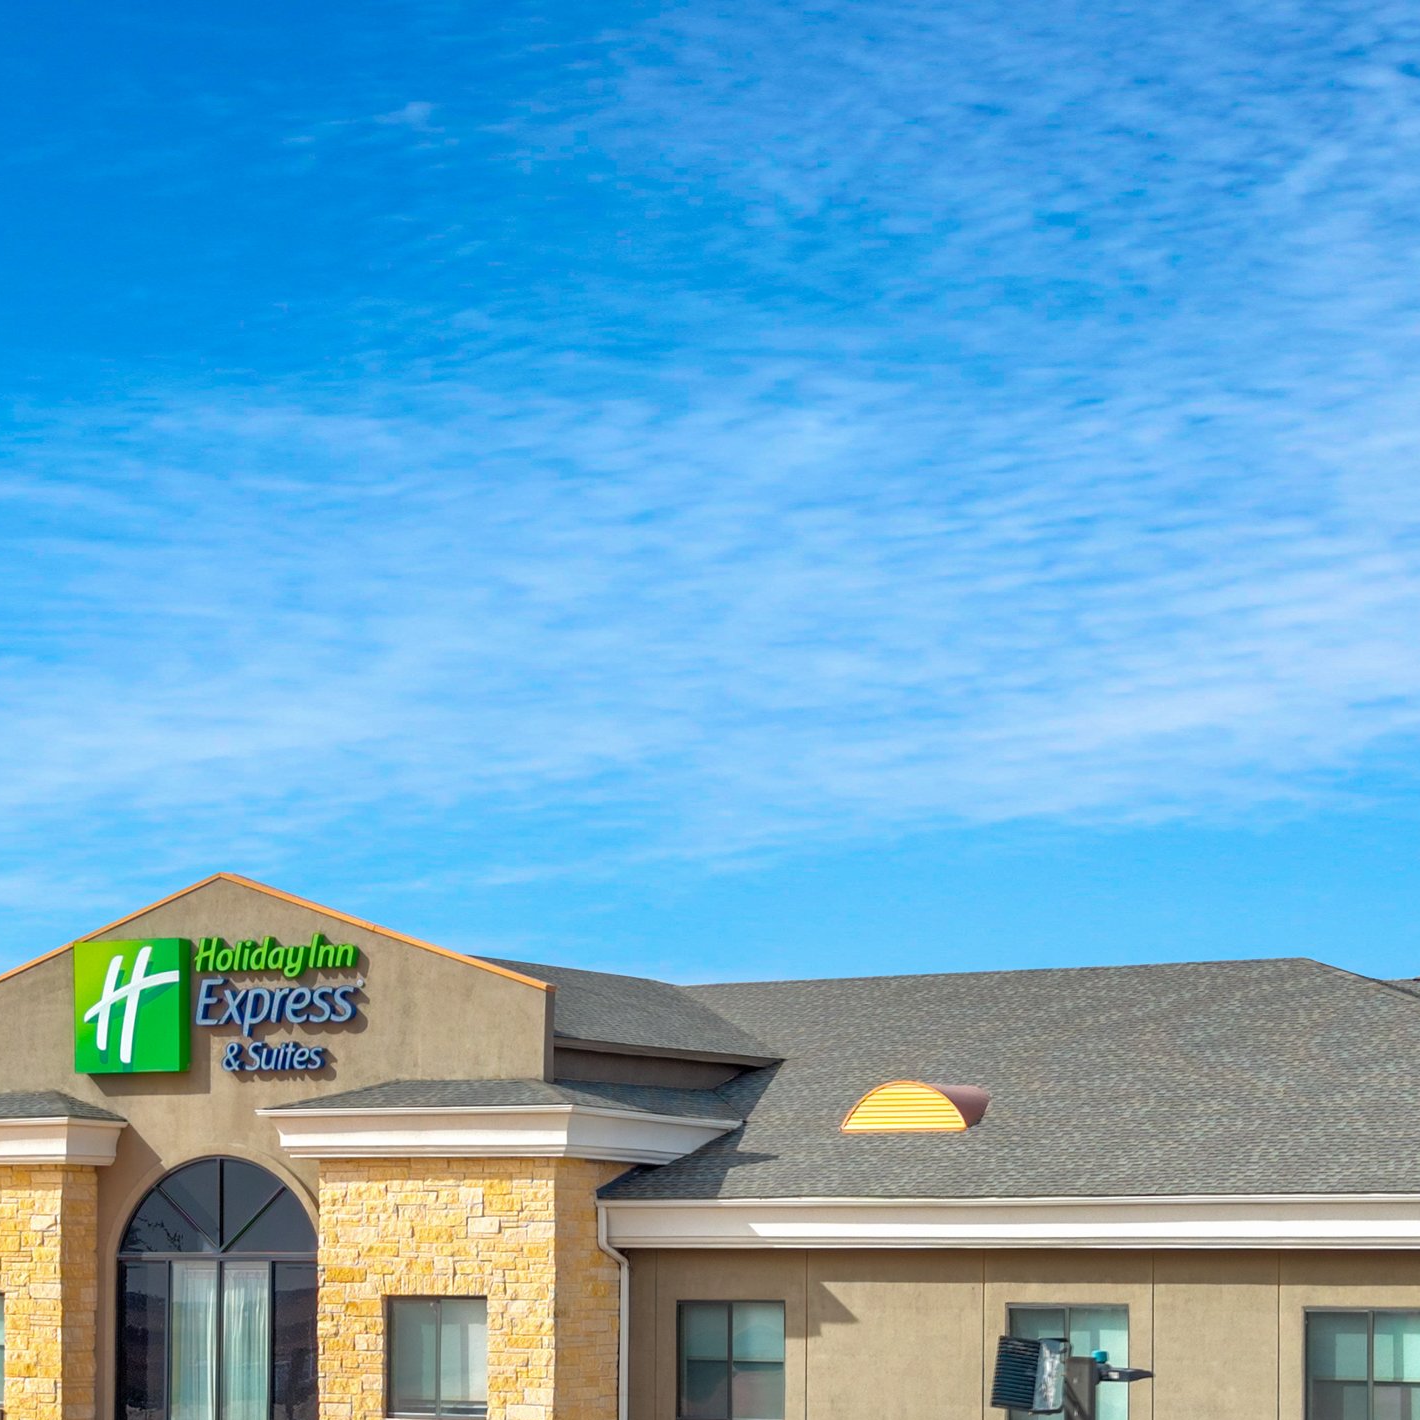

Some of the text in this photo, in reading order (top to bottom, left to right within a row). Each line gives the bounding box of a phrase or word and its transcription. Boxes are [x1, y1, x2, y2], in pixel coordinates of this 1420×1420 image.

[194, 932, 357, 978] Holiday Inn
[195, 977, 356, 1037] Express
[221, 1041, 323, 1072] & Suites
